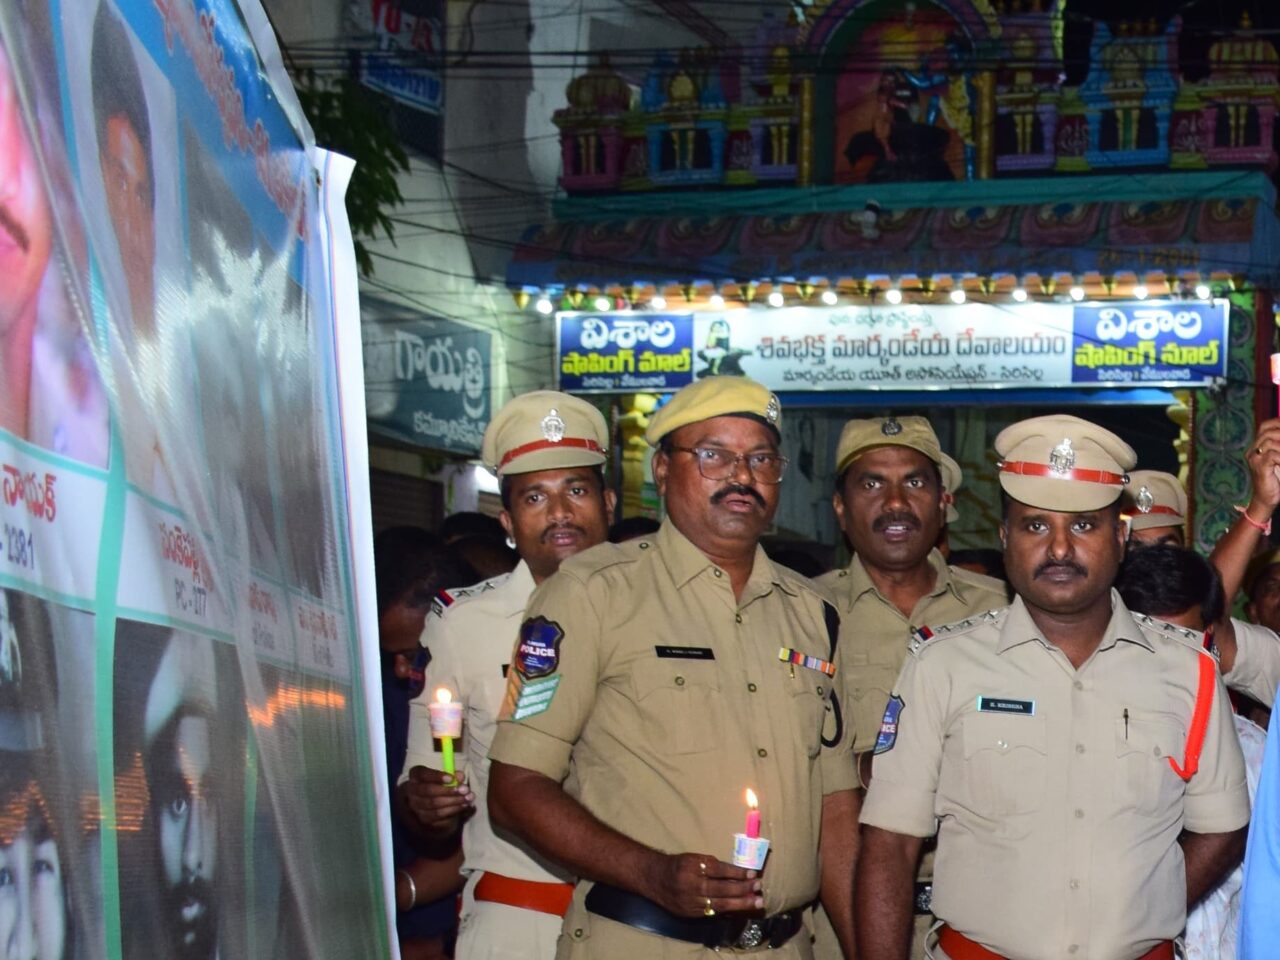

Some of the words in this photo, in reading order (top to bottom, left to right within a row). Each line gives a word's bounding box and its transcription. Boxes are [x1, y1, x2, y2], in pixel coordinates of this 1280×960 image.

[580, 318, 675, 350] విశాల
[1096, 308, 1202, 341] విశాల
[956, 328, 1066, 356] దేవాలయం
[520, 643, 556, 658] POLICE
